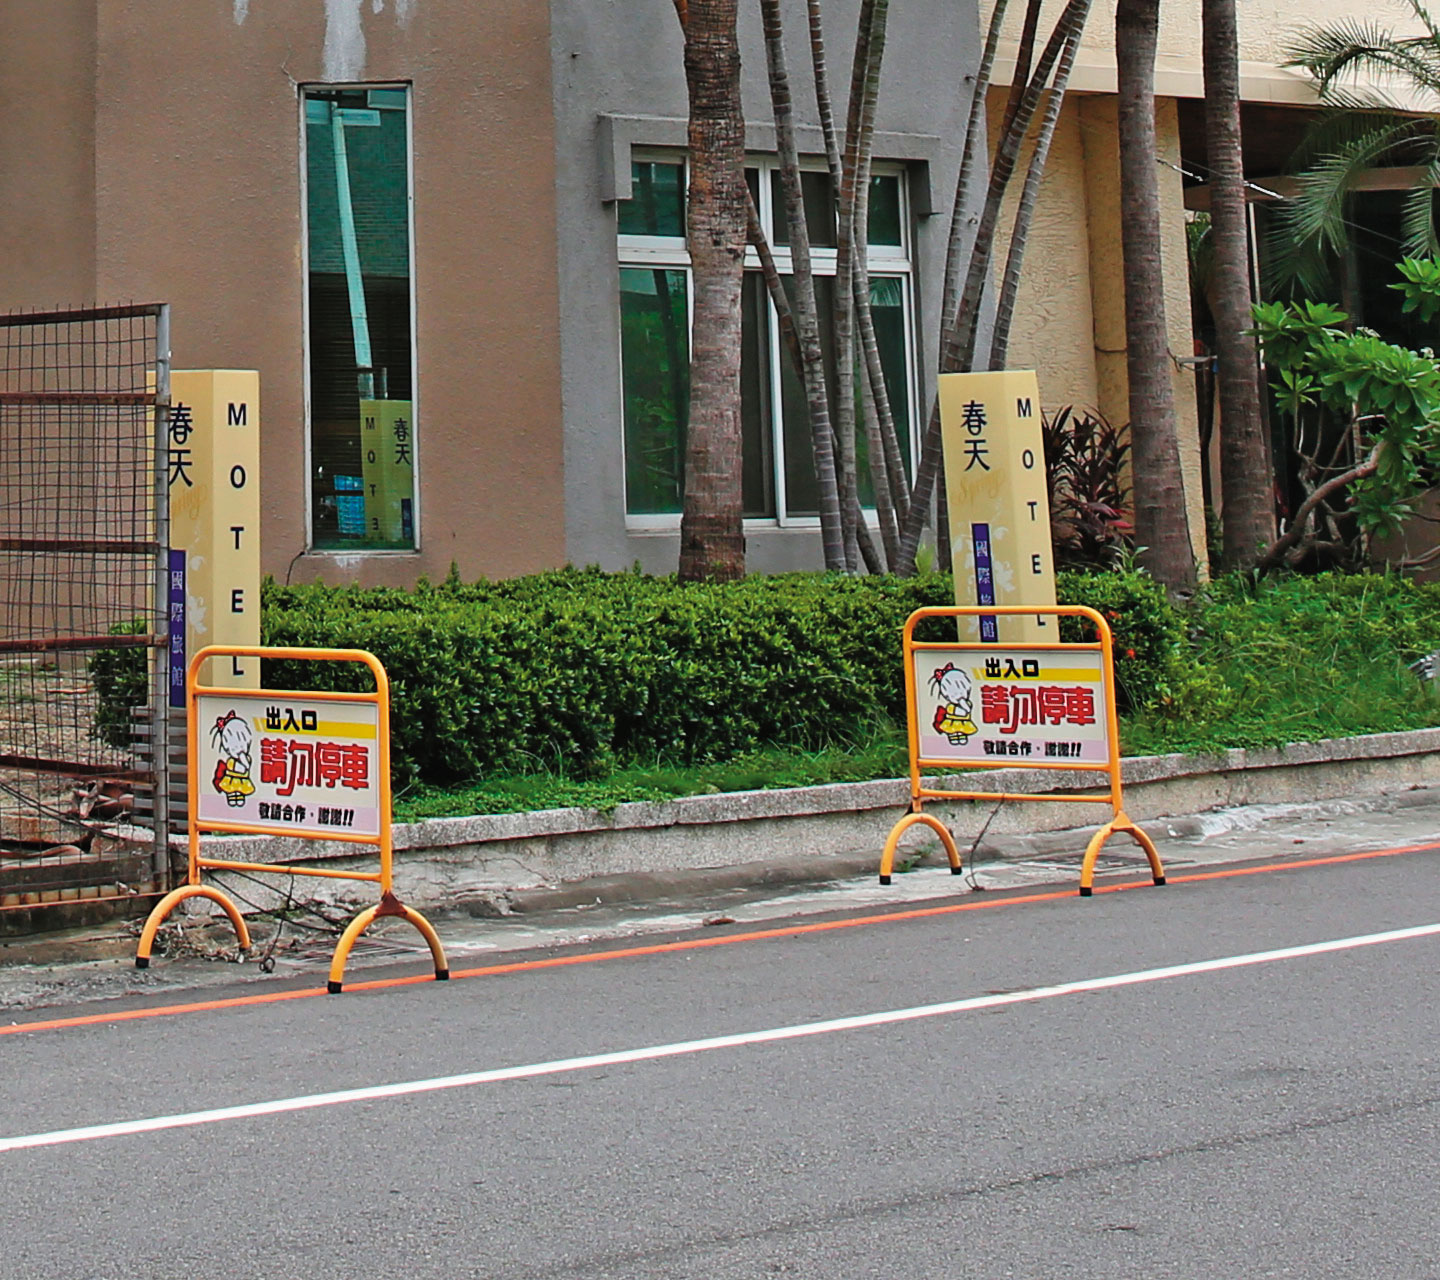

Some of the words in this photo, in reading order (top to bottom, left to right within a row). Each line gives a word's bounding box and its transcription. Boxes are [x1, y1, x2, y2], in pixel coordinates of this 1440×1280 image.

[169, 402, 193, 487] 春天
[960, 400, 990, 472] 春天
[228, 403, 247, 676] MOTEL
[1016, 398, 1046, 626] MOTEL
[171, 570, 184, 687] 國際旅館
[985, 657, 1039, 679] 出入口
[266, 706, 317, 731] 出入口
[981, 685, 1096, 734] 請勿停車
[260, 738, 369, 796] 請勿停車
